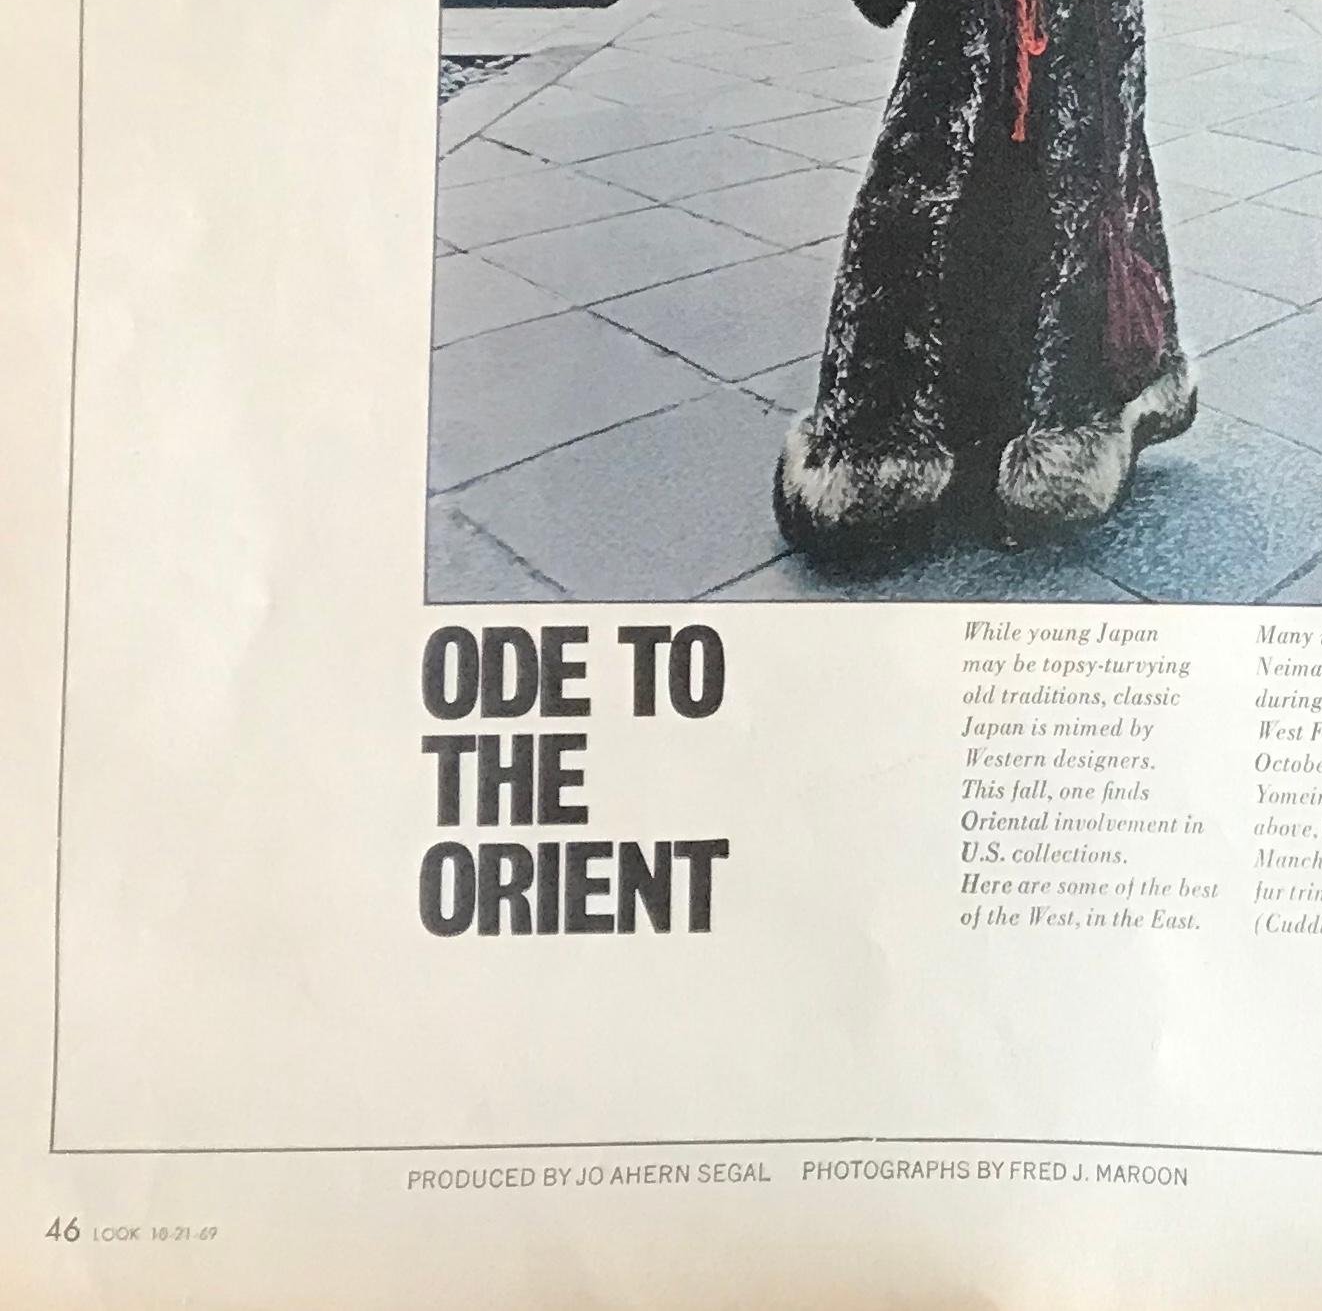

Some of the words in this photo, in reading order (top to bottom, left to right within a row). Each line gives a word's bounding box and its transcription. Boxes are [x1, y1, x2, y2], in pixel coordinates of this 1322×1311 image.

[964, 620, 1022, 642] While
[1026, 628, 1092, 646] young
[1096, 621, 1159, 647] Japan
[1255, 624, 1315, 650] Many
[421, 625, 591, 720] ODE
[618, 624, 725, 719] TO
[962, 659, 1007, 677] may
[1013, 652, 1037, 674] be
[1042, 655, 1192, 679] topsy-turvying
[962, 684, 996, 705] old
[1001, 684, 1107, 708] traditions,
[1112, 685, 1181, 707] classic
[960, 715, 1025, 741] Japan
[1031, 717, 1047, 737] is
[1053, 716, 1124, 737] mimed
[1129, 717, 1155, 742] by
[1258, 720, 1304, 742] West
[966, 746, 1047, 768] Western
[1053, 747, 1156, 773] designers.
[421, 733, 589, 826] THE
[961, 778, 1006, 800] This
[1010, 779, 1053, 803] fall,
[1059, 786, 1096, 801] one
[1100, 779, 1150, 804] finds
[960, 809, 1049, 832] Oriental
[1054, 811, 1178, 834] involvement
[1183, 813, 1205, 835] in
[1253, 815, 1318, 840] above,
[961, 840, 1006, 864] U.S.
[1011, 842, 1128, 865] collections.
[419, 839, 729, 937] ORIENT
[960, 872, 1013, 895] Here
[1017, 880, 1052, 895] are
[1056, 881, 1109, 896] some
[1114, 876, 1135, 901] of
[1140, 876, 1172, 897] the
[1178, 877, 1219, 899] best
[1253, 880, 1285, 905] fur
[959, 904, 982, 931] of
[986, 905, 1021, 927] the
[1029, 905, 1081, 930] West,
[1086, 907, 1106, 927] in
[1112, 907, 1145, 928] the
[1150, 908, 1201, 930] East.
[407, 1167, 536, 1191] PRODUCED
[543, 1166, 572, 1187] BY
[575, 1166, 604, 1187] JO
[609, 1164, 691, 1186] AHERN
[697, 1161, 772, 1184] SEGAL
[801, 1159, 971, 1181] PHOTOGRAPHS
[977, 1160, 1005, 1180] BY
[1009, 1160, 1067, 1182] FRED
[1072, 1163, 1089, 1182] J.
[1096, 1163, 1188, 1187] MAROON
[44, 1215, 81, 1243] 46
[93, 1226, 141, 1242] LOOK
